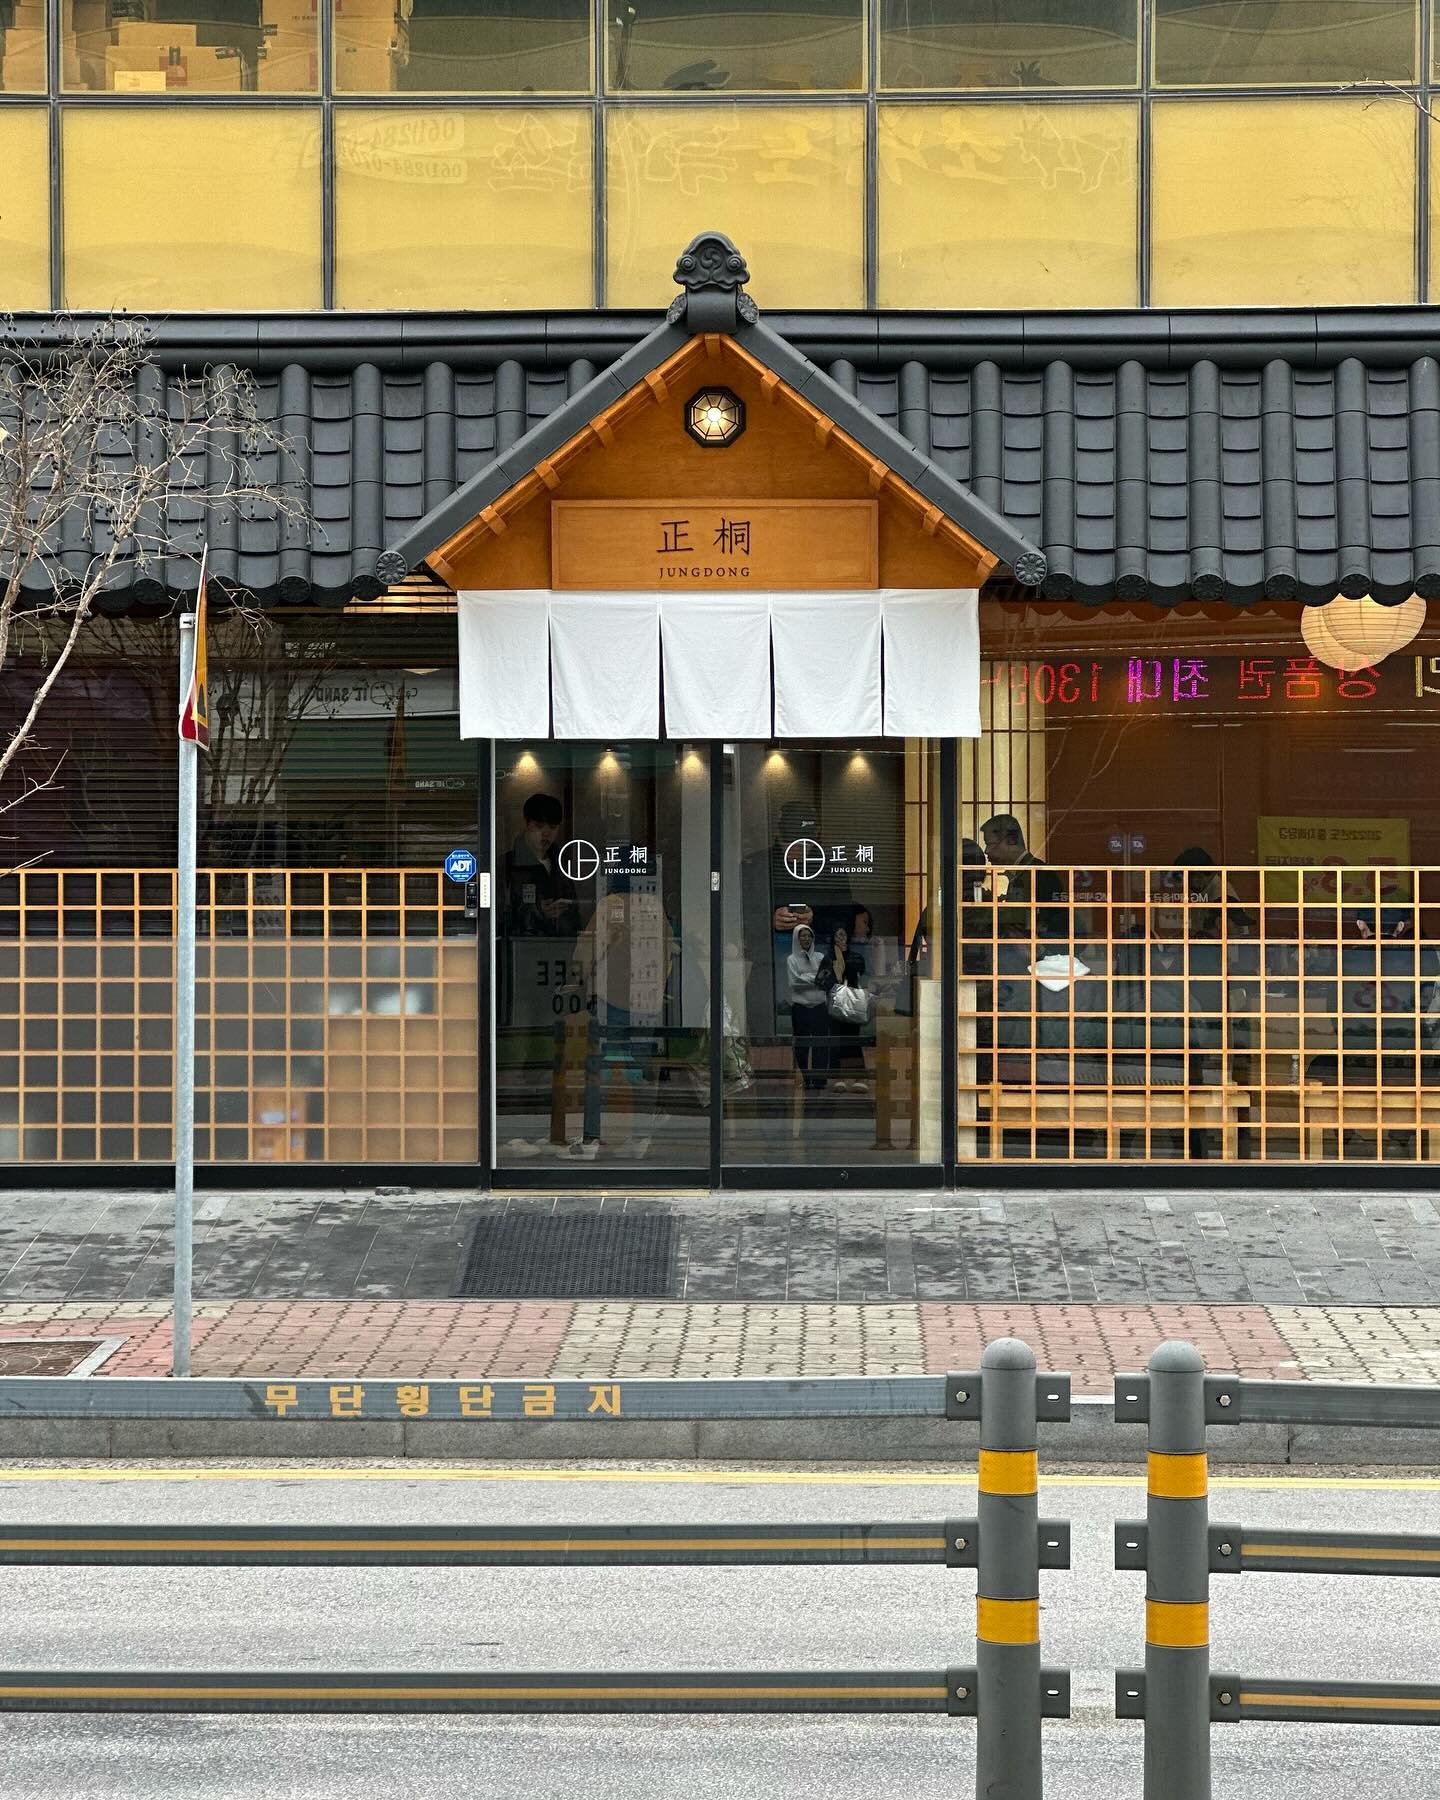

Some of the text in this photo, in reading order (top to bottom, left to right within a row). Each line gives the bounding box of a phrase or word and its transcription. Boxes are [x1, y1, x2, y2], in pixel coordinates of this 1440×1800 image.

[656, 517, 751, 556] 正桐
[659, 567, 751, 579] JUNGDONG
[603, 845, 648, 864] 正桐
[829, 844, 875, 863] 正桐
[450, 860, 472, 872] ADT
[604, 867, 647, 875] JUNGDONG
[830, 866, 874, 874] JUNGDONG
[264, 1384, 623, 1417] 무단횡단금지
